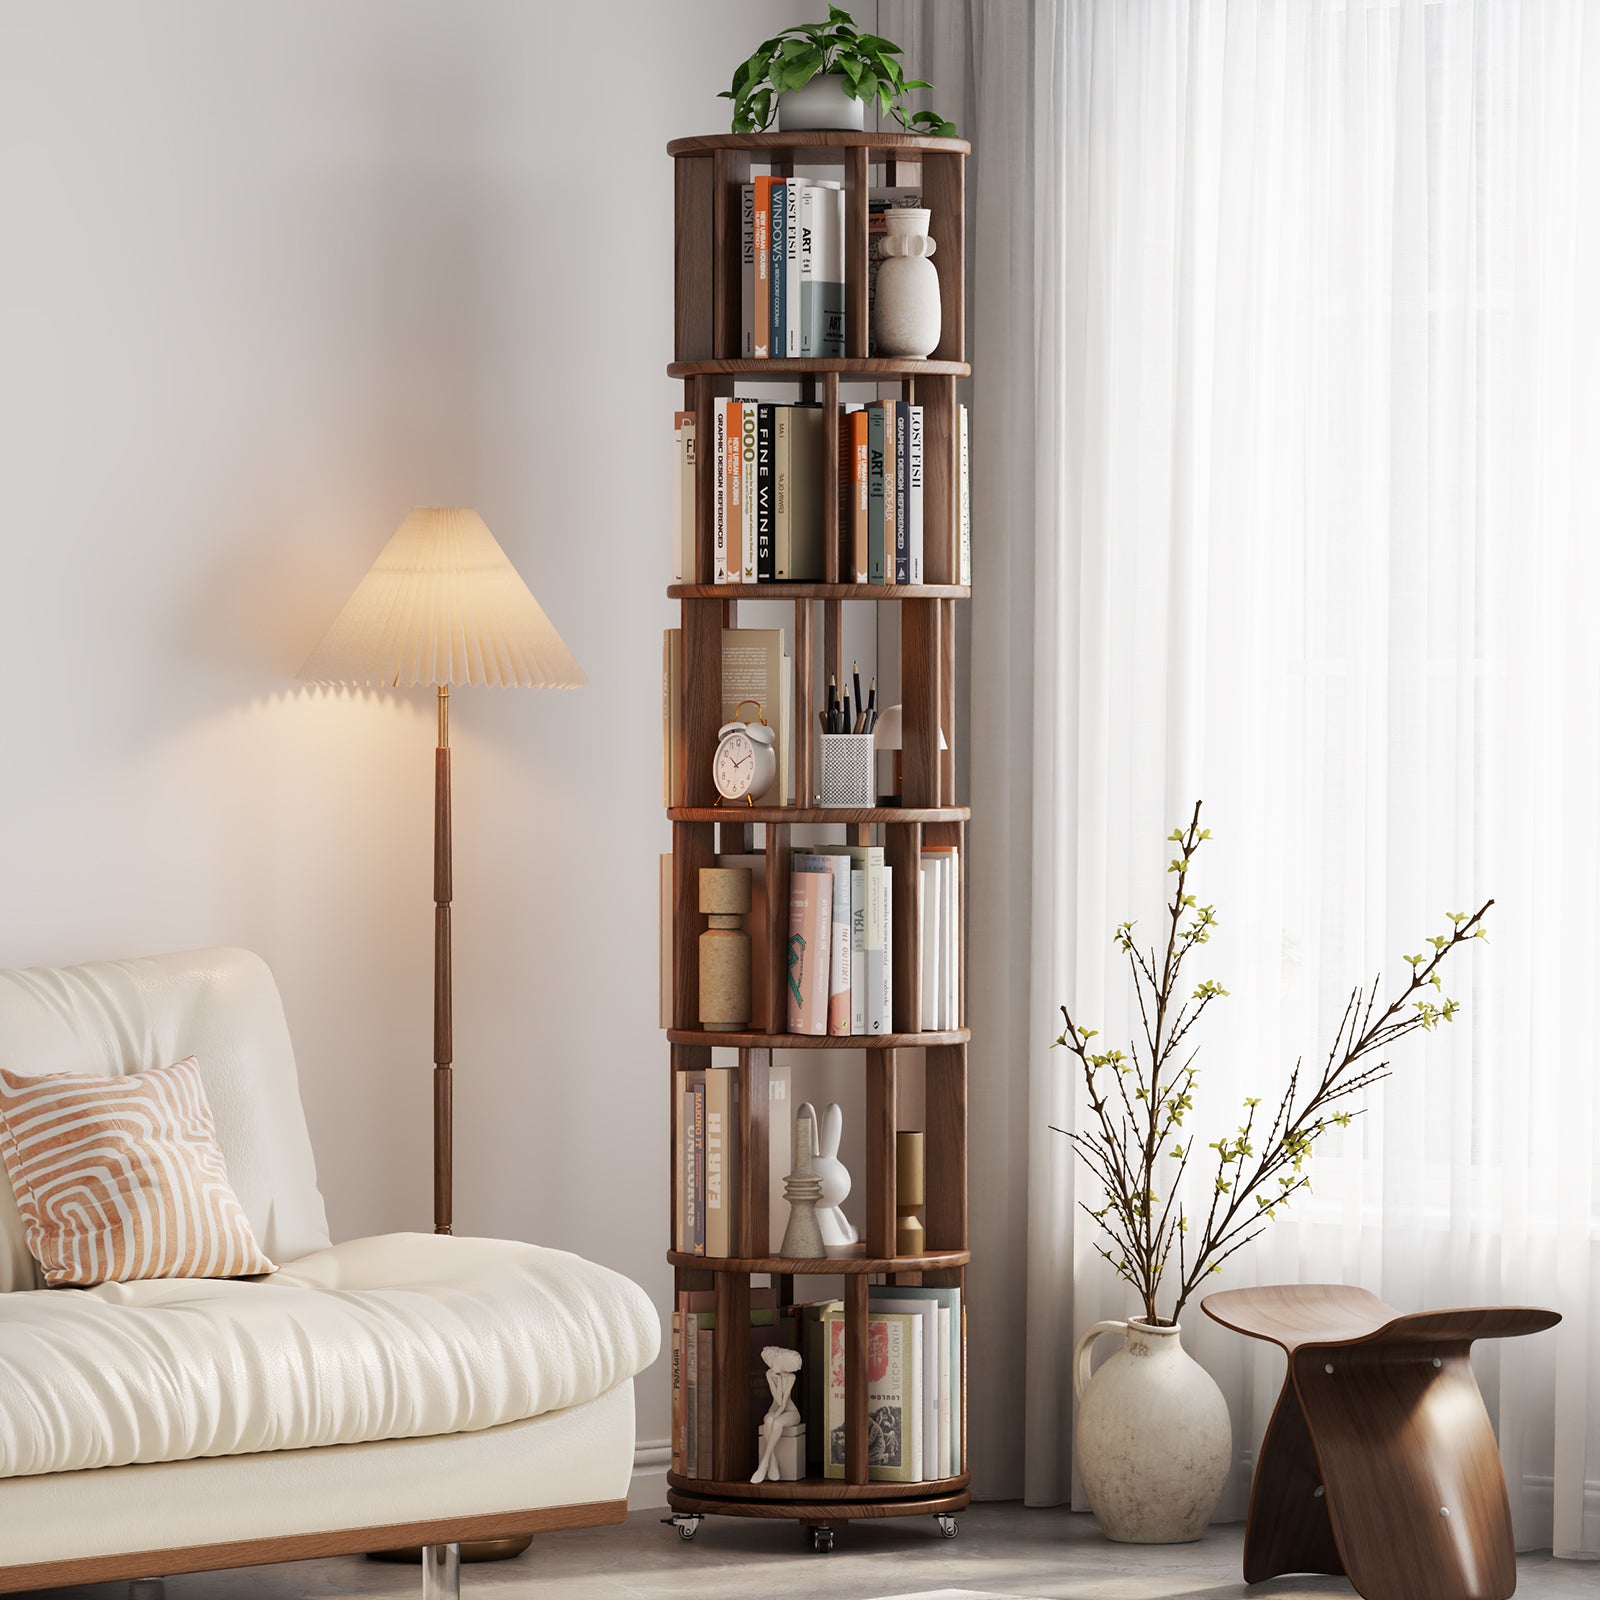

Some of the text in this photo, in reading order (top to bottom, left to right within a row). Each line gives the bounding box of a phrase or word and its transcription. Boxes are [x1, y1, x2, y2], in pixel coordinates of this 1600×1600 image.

[744, 189, 754, 264] LOST FISH
[772, 190, 782, 261] WINDOWS
[788, 183, 796, 260] LOST FISH
[802, 228, 811, 254] ART
[829, 316, 841, 330] ART
[743, 409, 756, 462] 1000
[759, 428, 769, 477] FINE
[912, 411, 921, 488] LOST FISH
[871, 449, 884, 478] ART
[759, 486, 769, 559] WINES
[885, 473, 894, 522] BORDEAUX
[695, 1137, 702, 1149] IT
[708, 1112, 721, 1209] EARTH
